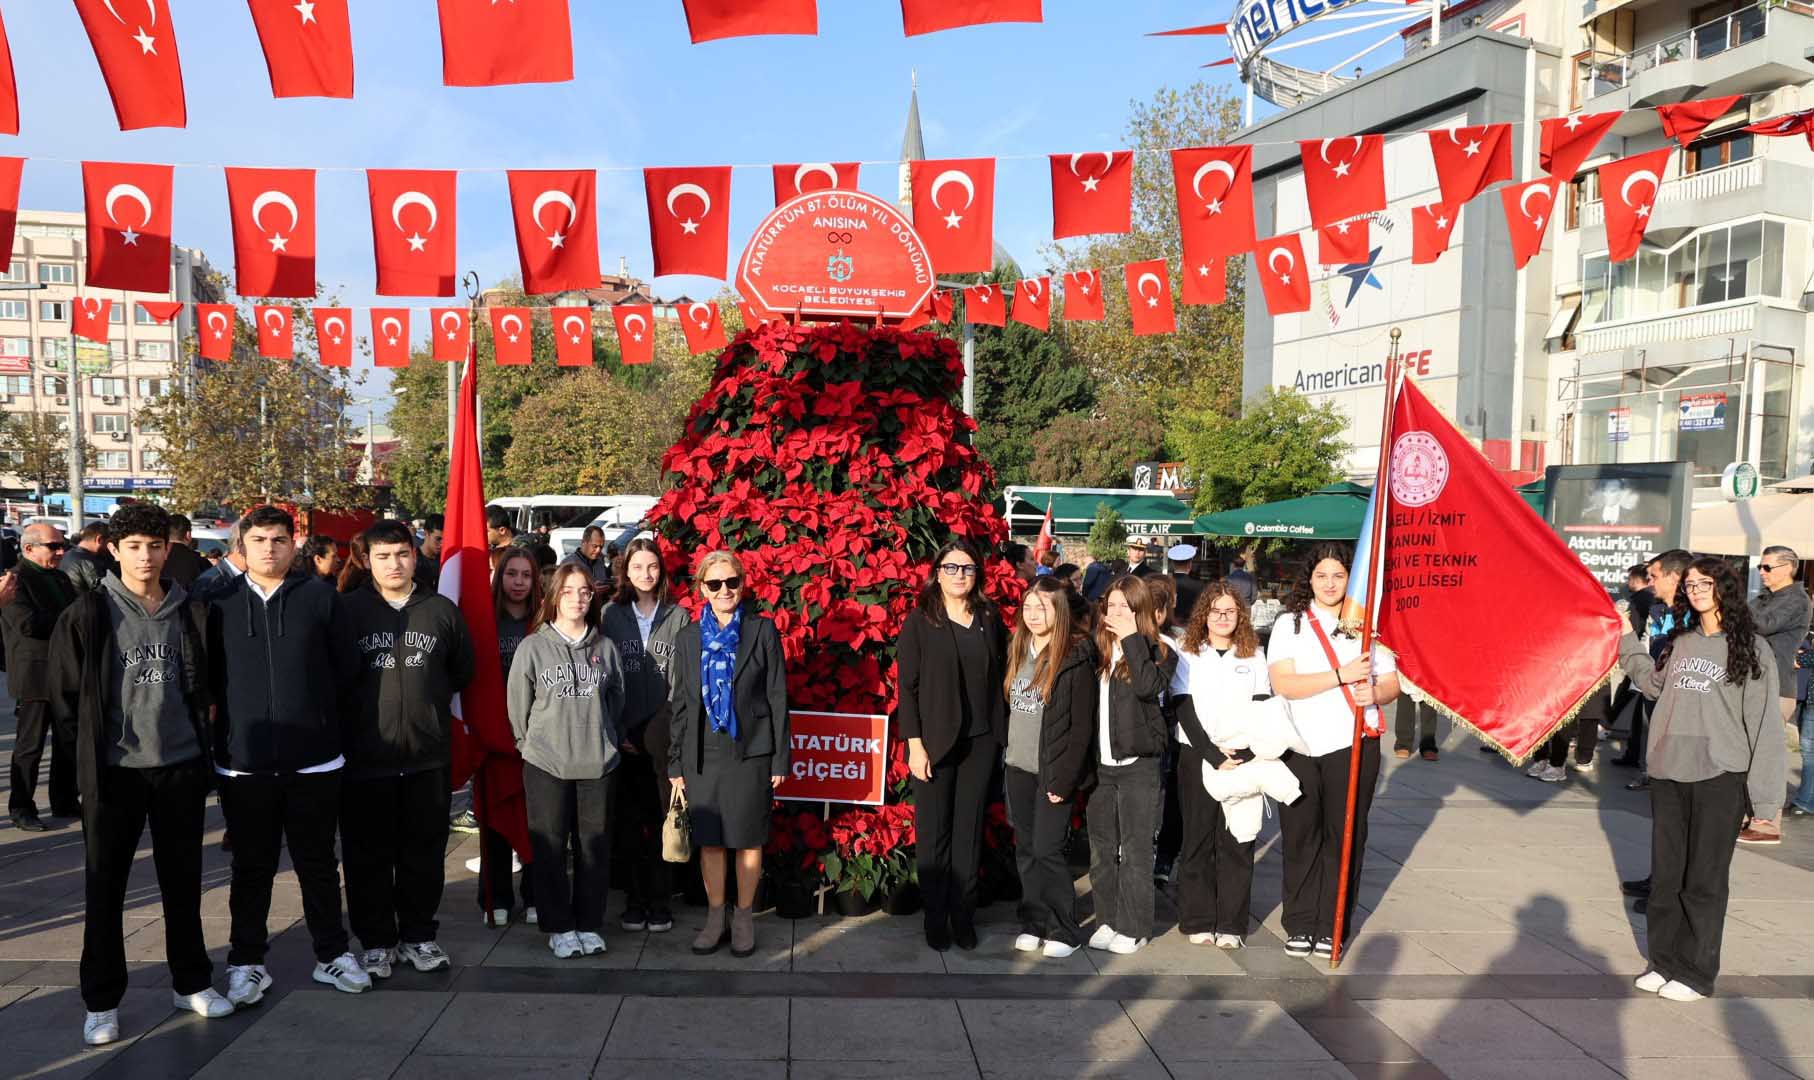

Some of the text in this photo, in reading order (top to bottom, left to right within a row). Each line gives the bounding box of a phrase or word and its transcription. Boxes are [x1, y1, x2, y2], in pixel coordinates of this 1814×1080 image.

[813, 216, 868, 230] ANISINA
[751, 196, 929, 284] ATATÜRK'ÜN 87. ÖLÜM YIL DÖNÜMÜ
[804, 295, 876, 305] BELEDİYESİ
[1428, 509, 1466, 526] İZMİT
[1256, 524, 1314, 535] Colombia Coffee
[1568, 535, 1653, 551] Atatürk'ün
[1404, 554, 1420, 567] VE
[1424, 552, 1477, 567] TEKNİK
[1419, 571, 1463, 588] LİSESİ
[1396, 595, 1420, 612] 2000
[792, 758, 866, 782] ÇİÇEĞİ
